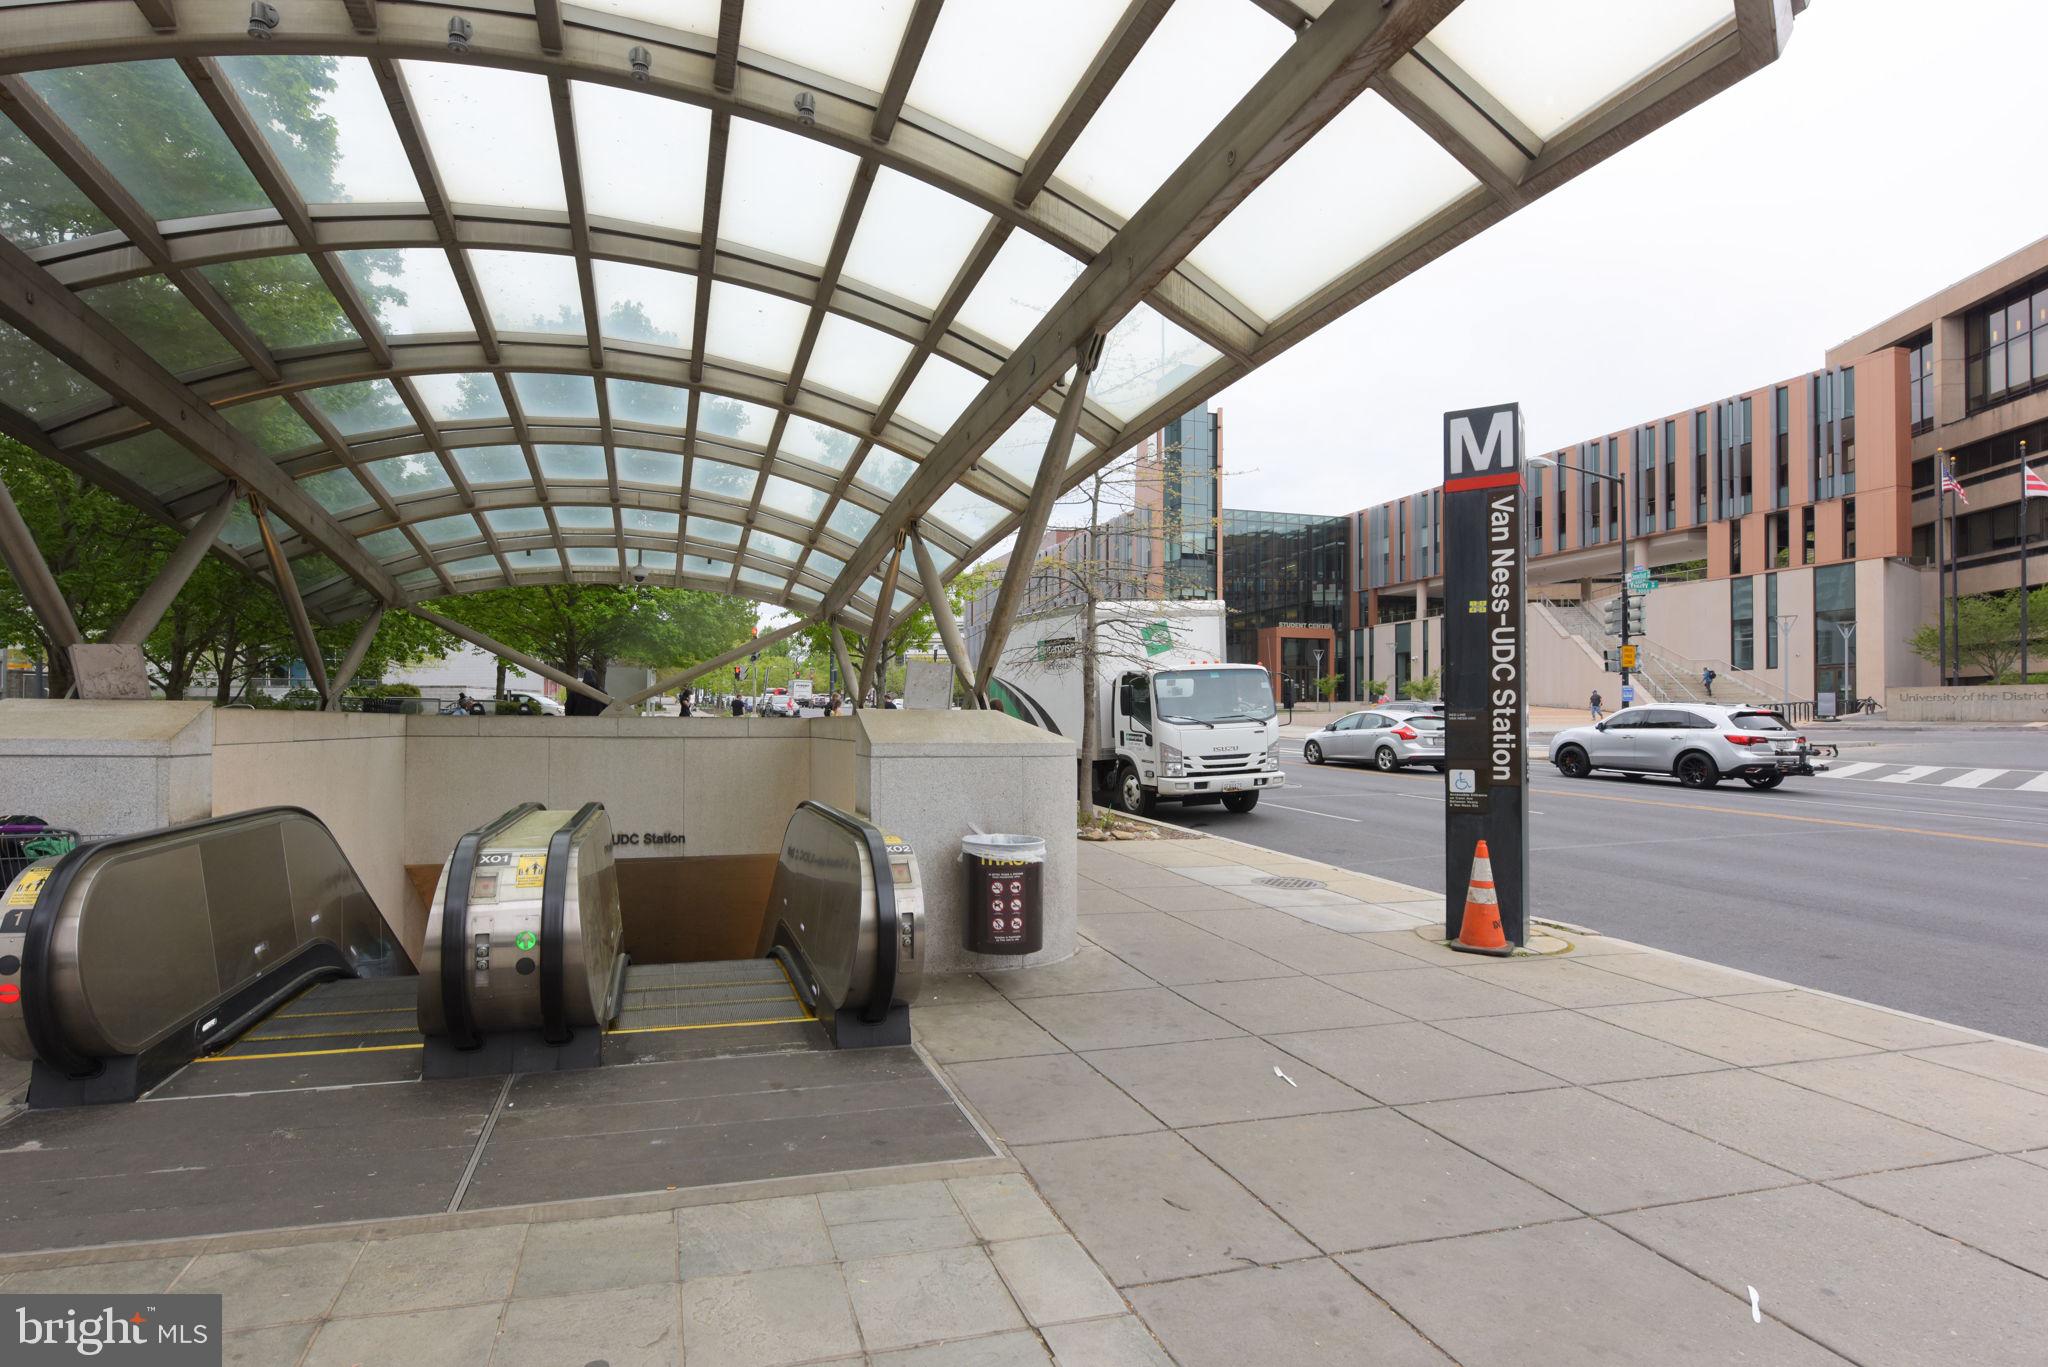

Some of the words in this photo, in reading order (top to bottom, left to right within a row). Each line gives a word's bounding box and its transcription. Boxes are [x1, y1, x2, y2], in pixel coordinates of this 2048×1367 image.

[1450, 411, 1514, 474] M
[1491, 494, 1515, 542] Van
[1491, 548, 1516, 682] Ness-UDC
[1900, 692, 1959, 704] University
[1962, 692, 1974, 701] of
[1977, 692, 1998, 701] the
[1492, 689, 1517, 781] Station
[643, 833, 686, 845] Station
[15, 911, 23, 926] 1
